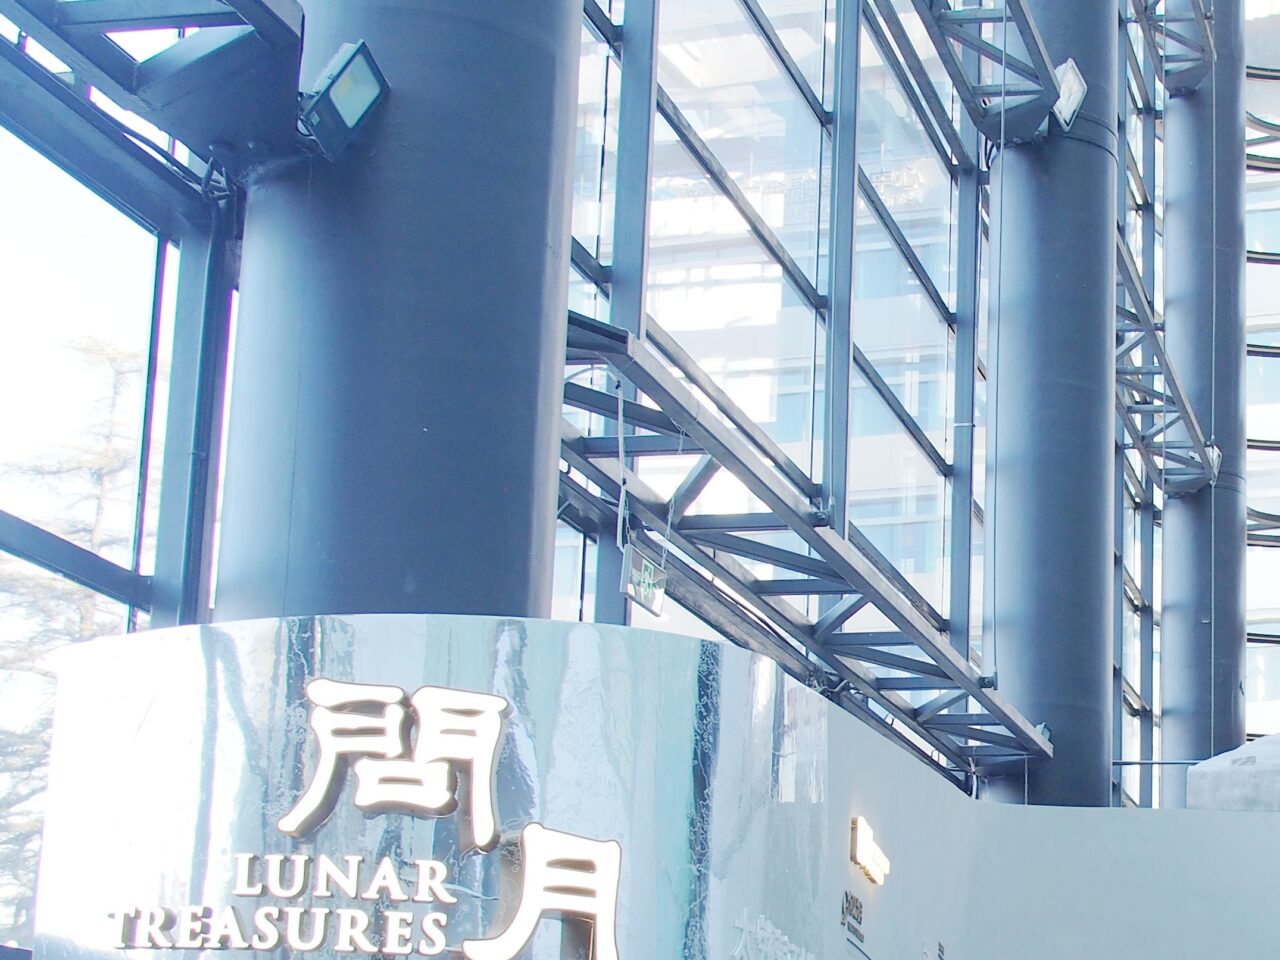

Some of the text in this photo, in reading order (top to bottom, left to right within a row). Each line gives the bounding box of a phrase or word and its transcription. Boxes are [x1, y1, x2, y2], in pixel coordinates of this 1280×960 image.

[277, 677, 510, 849] 問
[231, 852, 458, 904] LUNAR
[106, 904, 450, 957] TREASURES
